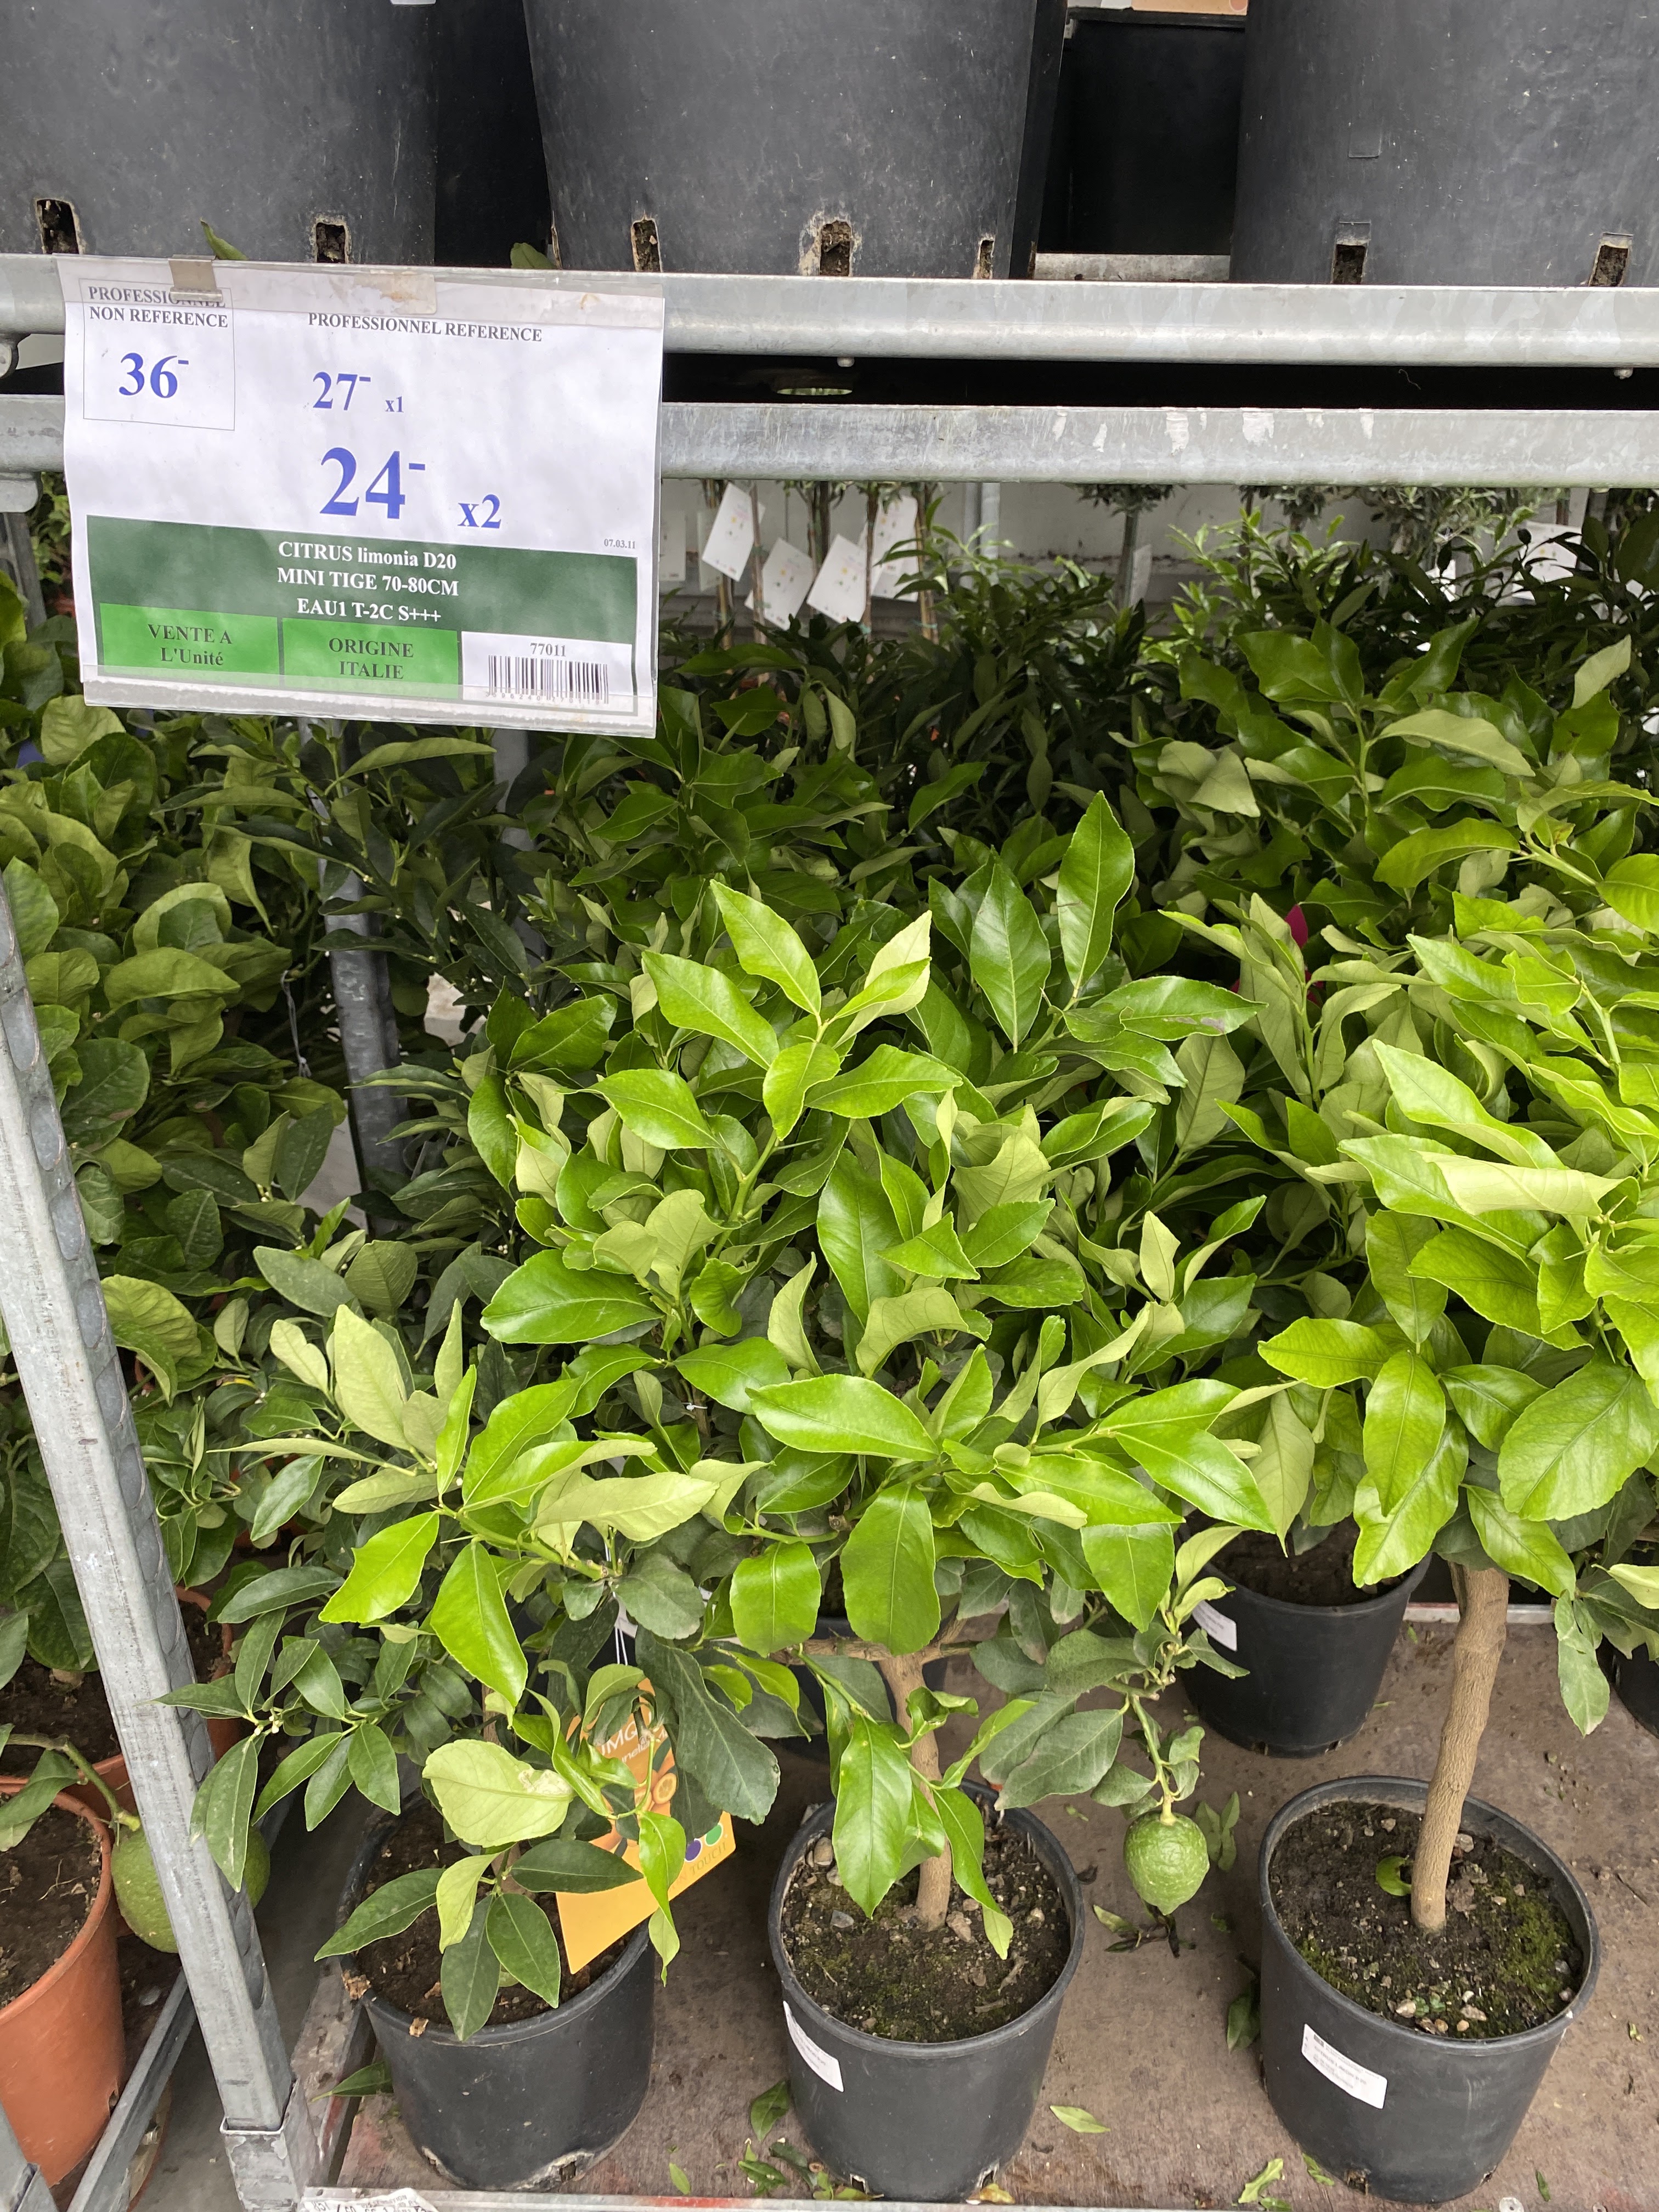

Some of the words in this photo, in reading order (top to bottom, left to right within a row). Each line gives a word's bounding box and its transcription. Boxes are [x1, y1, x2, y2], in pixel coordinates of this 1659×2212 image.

[89, 306, 125, 321] NON
[129, 308, 228, 328] REFERENCE
[308, 312, 441, 335] PROFESSIONNEL
[445, 321, 542, 342] REFERENCE
[385, 396, 404, 413] x1
[458, 494, 501, 529] x2
[278, 540, 353, 562] CITRUS
[358, 547, 419, 567] limonia
[424, 552, 456, 569] D20
[603, 538, 636, 550] 07.03.11
[277, 567, 325, 587] MINI
[329, 571, 377, 591] TIGE
[382, 575, 459, 596] 70-80CM
[297, 598, 346, 617] EAU1
[351, 602, 393, 621] T-2C
[398, 605, 441, 623] S+++
[148, 624, 215, 644] VENTE
[220, 630, 233, 645] A
[161, 647, 224, 667] L'Unité
[329, 637, 414, 658] ORIGINE
[530, 642, 567, 657] 77011
[339, 661, 404, 680] ITALIE
